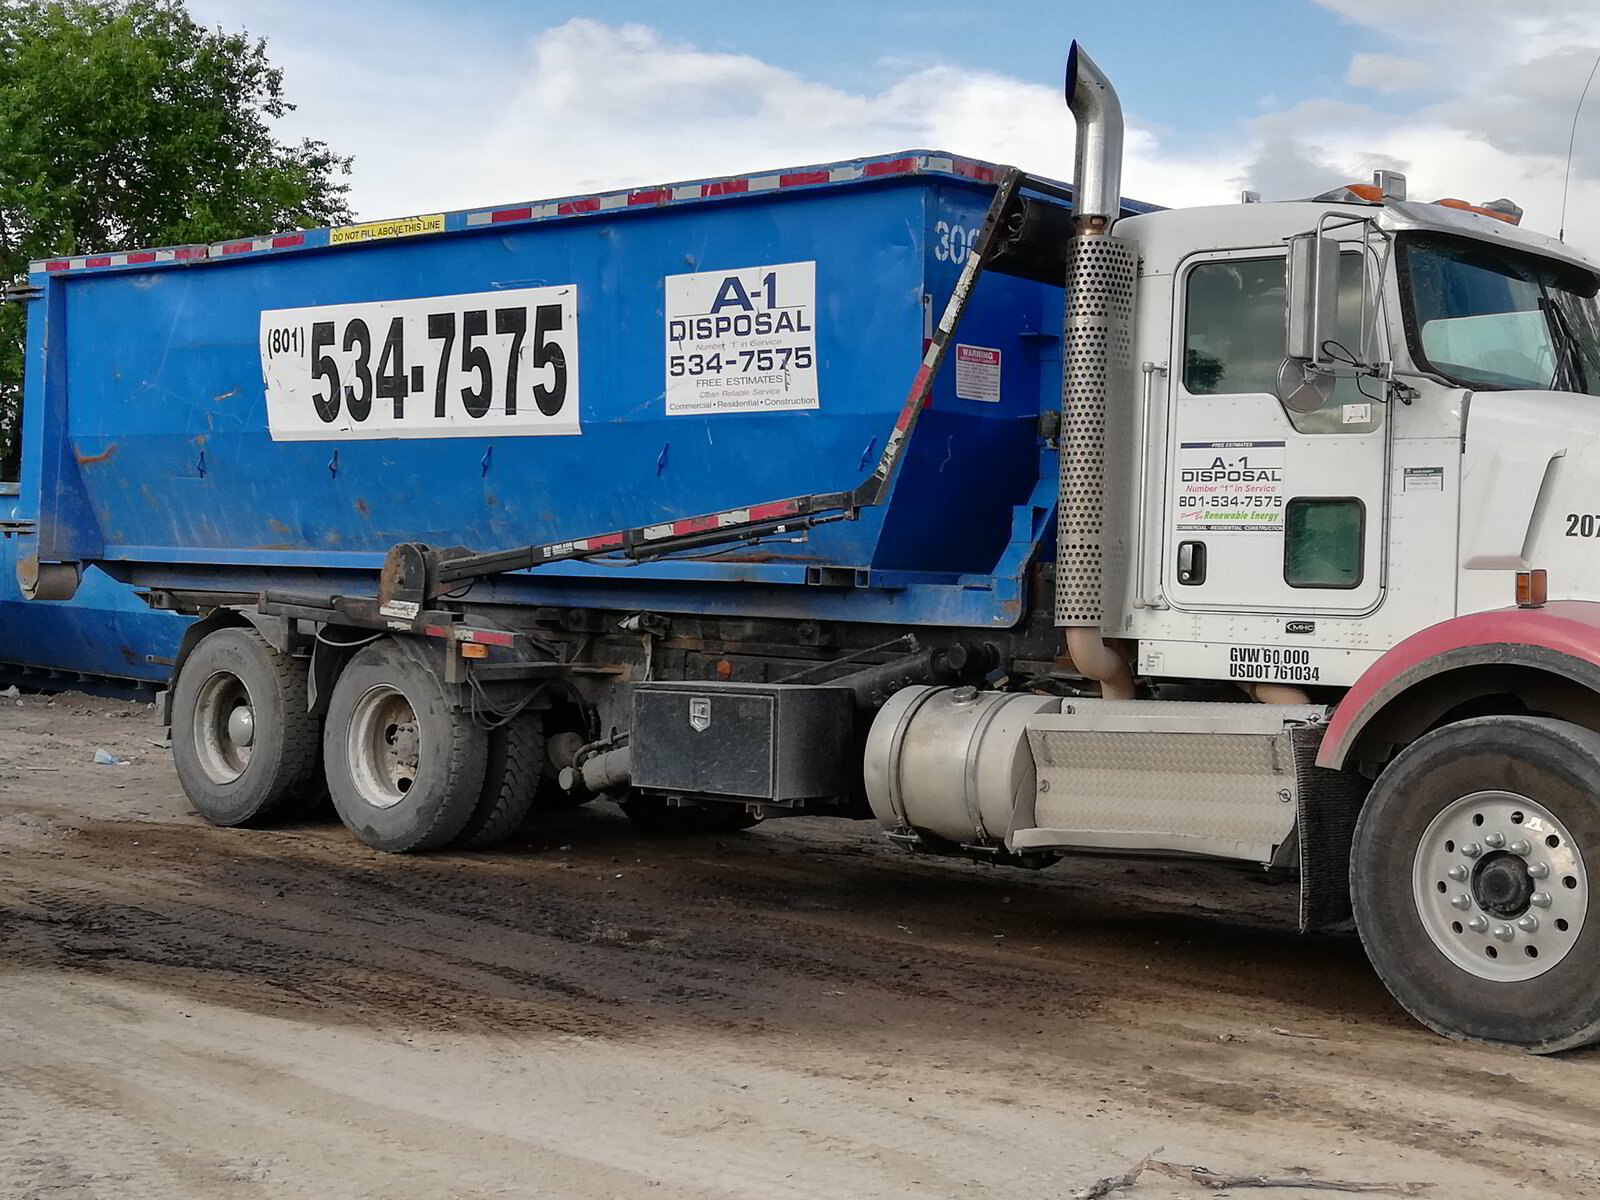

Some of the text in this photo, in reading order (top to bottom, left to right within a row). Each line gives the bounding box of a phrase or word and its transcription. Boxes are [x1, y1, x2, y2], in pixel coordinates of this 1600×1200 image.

[333, 220, 440, 242] DO NOT FILL ABOVE THIS LINE
[710, 271, 776, 314] A-1
[669, 310, 811, 342] DISPOSAL
[696, 341, 725, 351] Number
[741, 339, 748, 348] in
[750, 338, 782, 347] Service
[962, 347, 993, 360] WARNING
[267, 303, 567, 423] (801) 534-7575
[670, 346, 812, 377] 534-7575
[696, 375, 783, 388] FREE ESTIMATES
[699, 387, 781, 399] Clean Reliable Service
[669, 397, 815, 411] Commercial Residential Construction
[1181, 470, 1281, 482] DISPOSAL
[1235, 484, 1243, 492] in
[1245, 484, 1276, 492] Service
[1179, 496, 1282, 507] 801-534-7575
[1203, 511, 1280, 522] Renewable Energy
[1229, 647, 1310, 665] GVW 60,000
[1229, 663, 1320, 681] USDOT 761034
